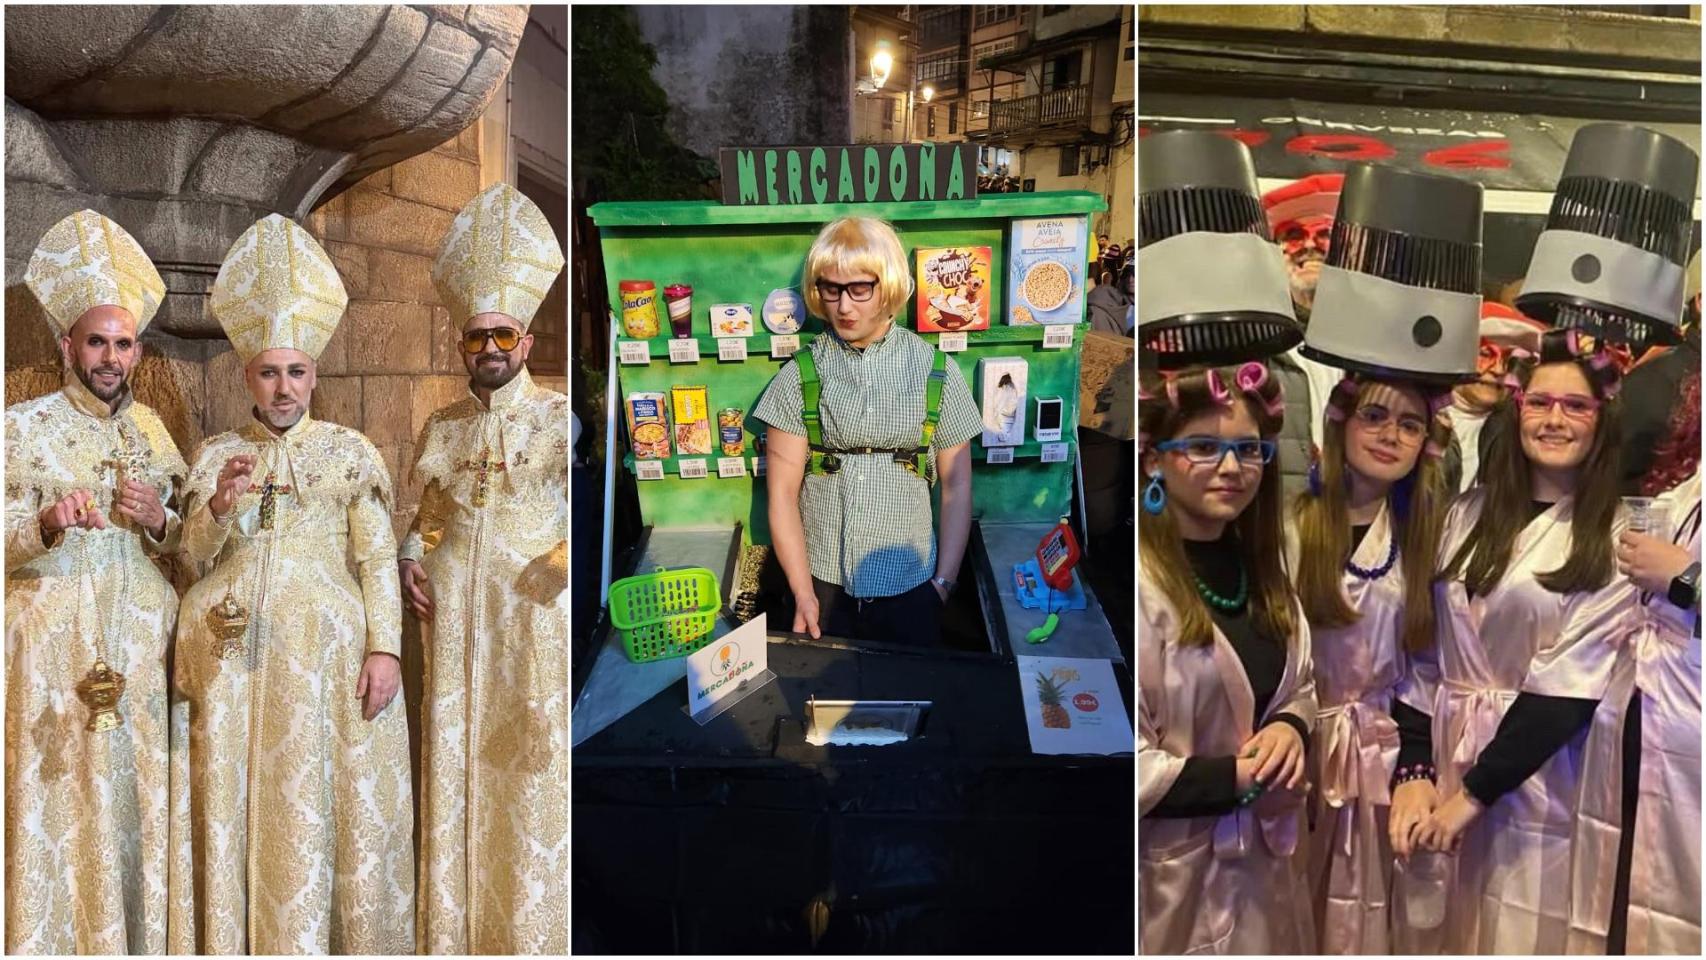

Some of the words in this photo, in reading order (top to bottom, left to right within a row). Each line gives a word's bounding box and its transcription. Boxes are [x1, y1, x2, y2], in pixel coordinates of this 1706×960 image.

[737, 142, 965, 205] MERCADOÑA
[1036, 220, 1063, 228] AVENA
[938, 253, 969, 275] CRUNCHY
[943, 271, 968, 287] CHOC
[623, 296, 652, 309] olaCao
